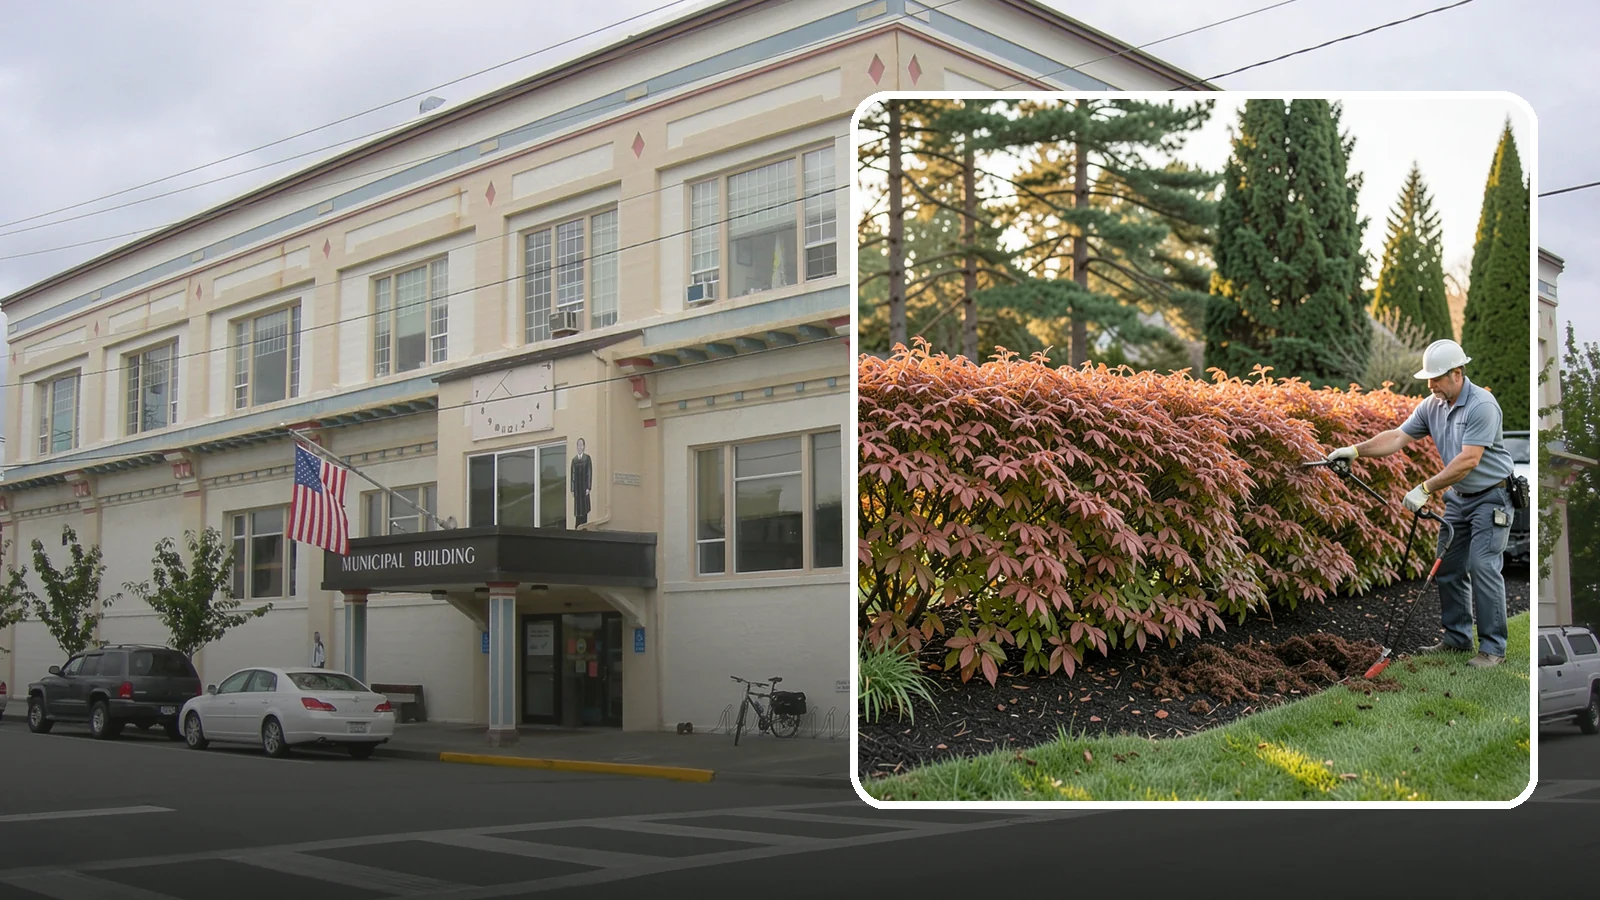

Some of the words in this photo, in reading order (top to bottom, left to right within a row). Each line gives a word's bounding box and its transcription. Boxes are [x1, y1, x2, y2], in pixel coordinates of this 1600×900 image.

[480, 407, 485, 415] 8
[488, 417, 492, 425] 9
[528, 414, 533, 422] 3
[507, 425, 513, 433] 12
[342, 553, 405, 571] MUNICIPAL
[414, 547, 475, 567] BUILDING
